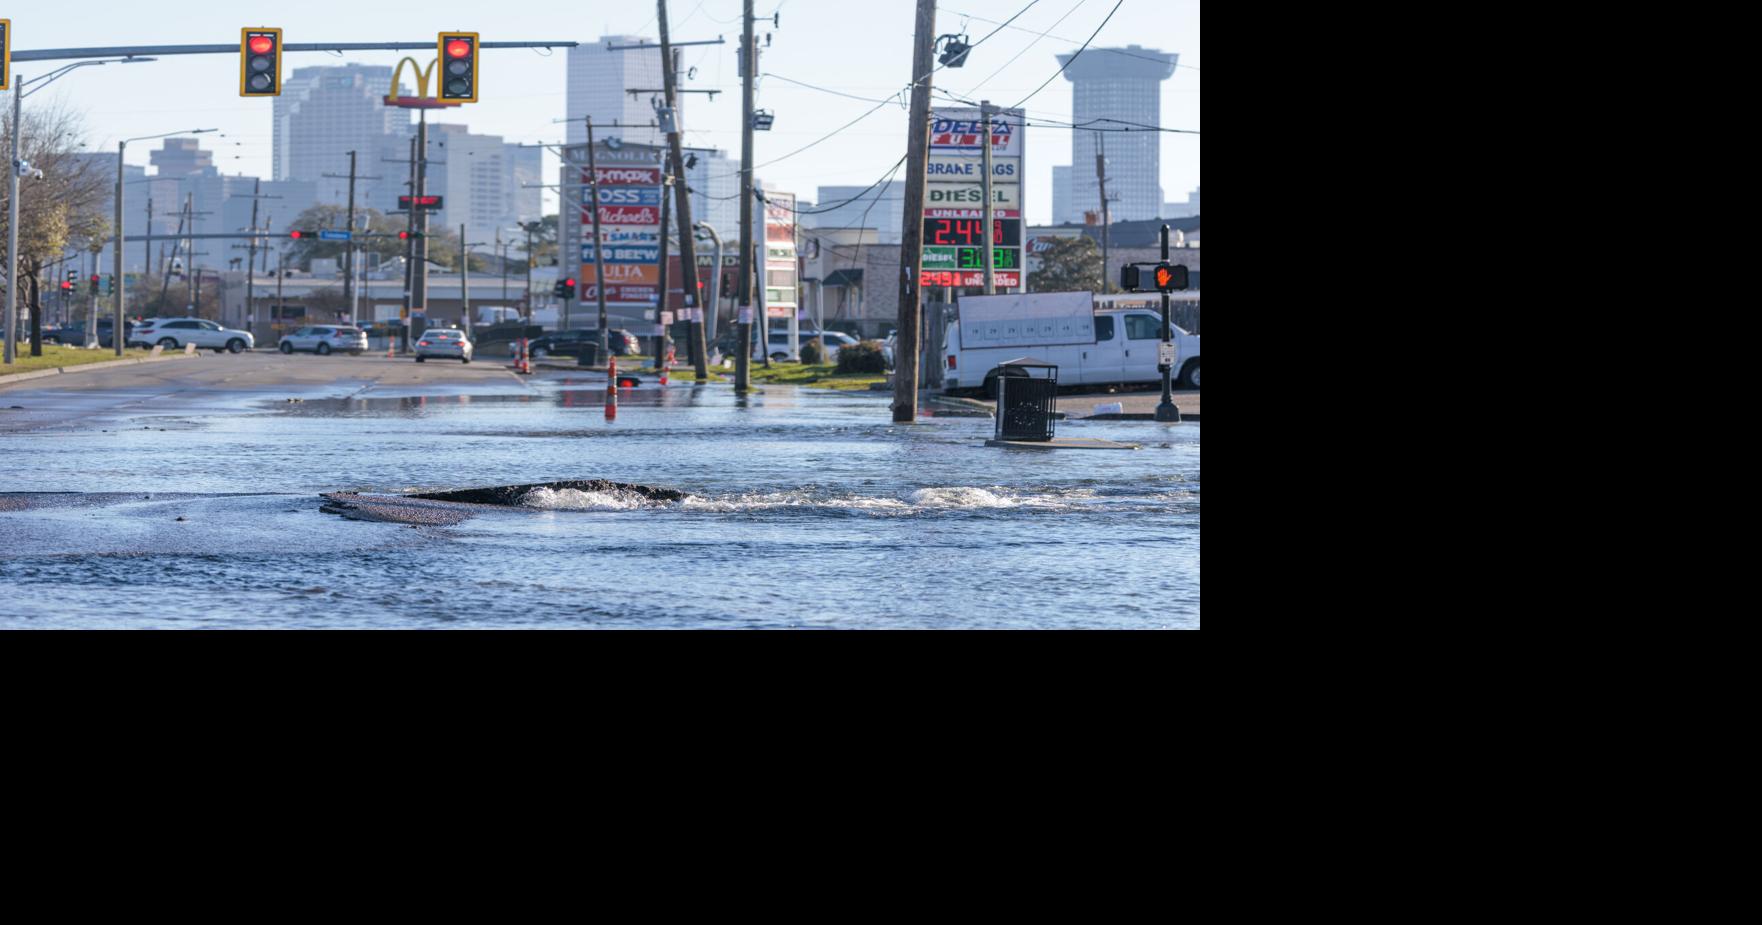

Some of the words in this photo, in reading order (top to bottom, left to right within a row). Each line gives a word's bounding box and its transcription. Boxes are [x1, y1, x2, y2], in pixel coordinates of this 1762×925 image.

[571, 150, 657, 160] MGNOLIA
[927, 163, 972, 174] BRAKE
[977, 164, 1013, 175] TGS
[930, 190, 1010, 202] DIESL
